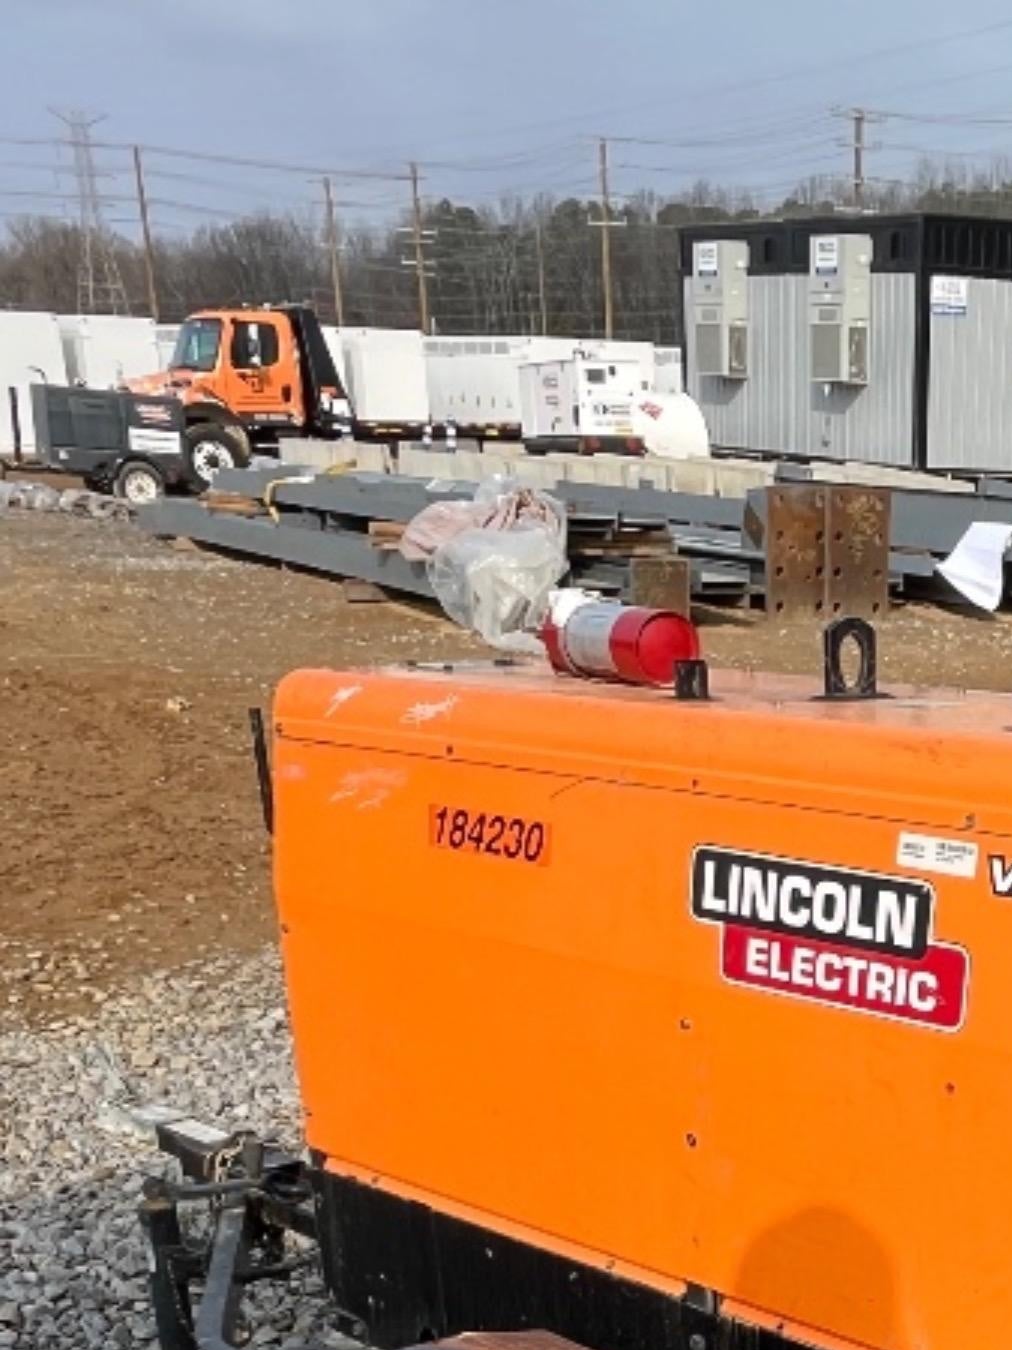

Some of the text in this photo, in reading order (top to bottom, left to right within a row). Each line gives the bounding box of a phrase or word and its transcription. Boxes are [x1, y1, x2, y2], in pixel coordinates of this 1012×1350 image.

[435, 806, 544, 862] 184230
[700, 858, 920, 949] LINCOLN
[744, 938, 938, 1012] ELECTRIC
